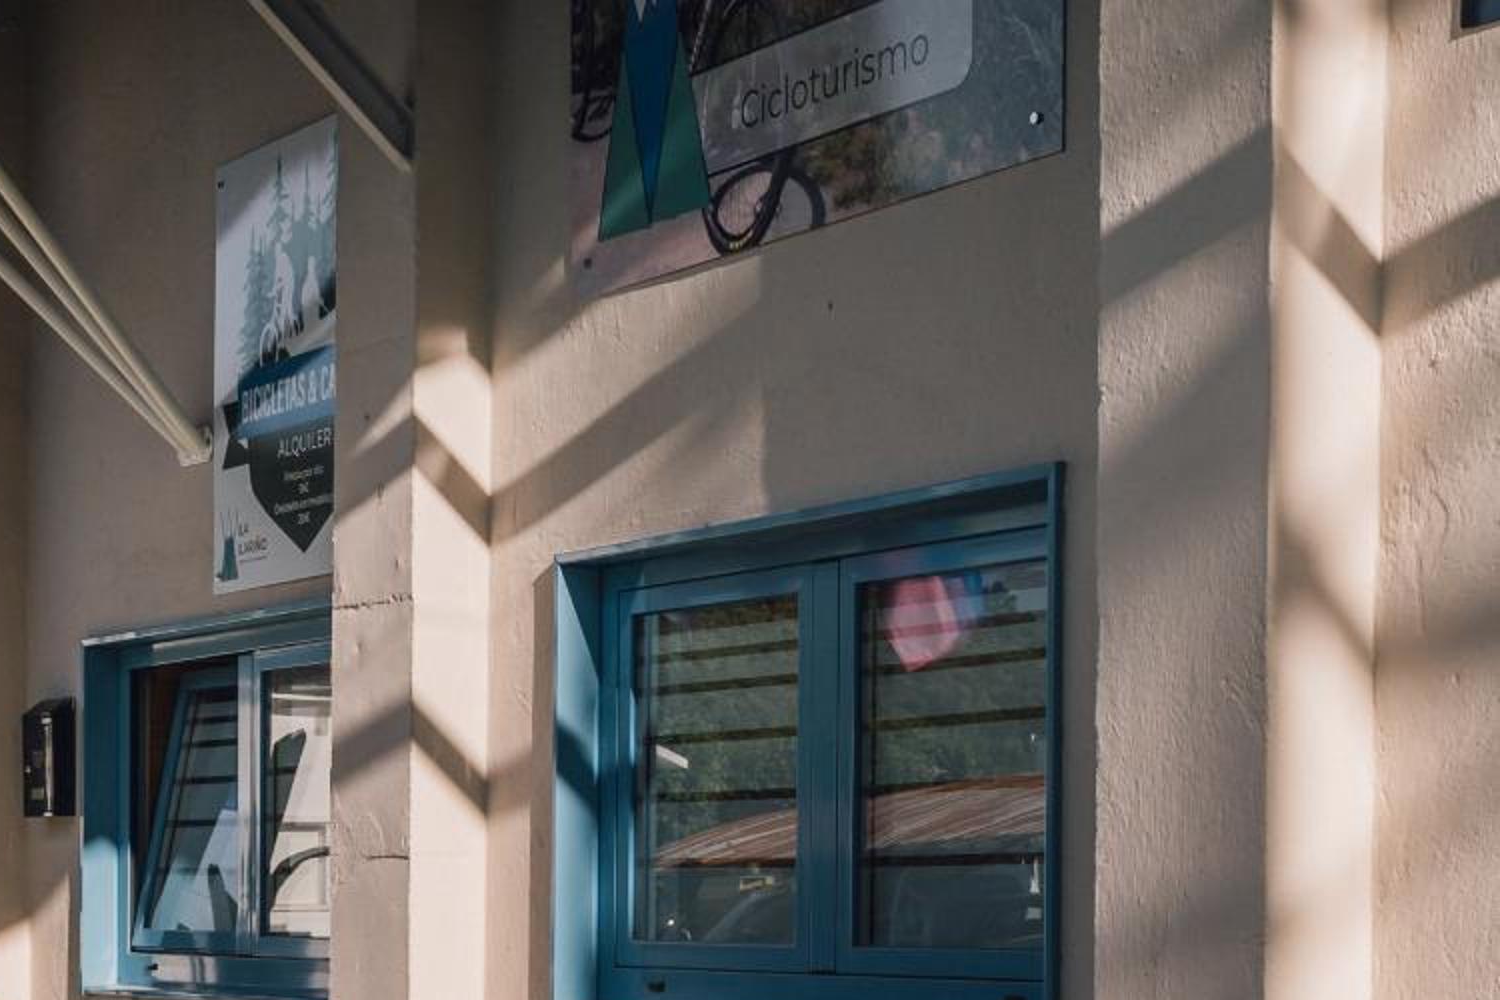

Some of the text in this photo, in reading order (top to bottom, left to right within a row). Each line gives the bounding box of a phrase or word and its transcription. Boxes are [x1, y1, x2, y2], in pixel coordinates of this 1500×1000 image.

[741, 34, 929, 128] Cicloturismo
[242, 371, 305, 425] BICICLETAS
[277, 427, 332, 459] ALQUILER
